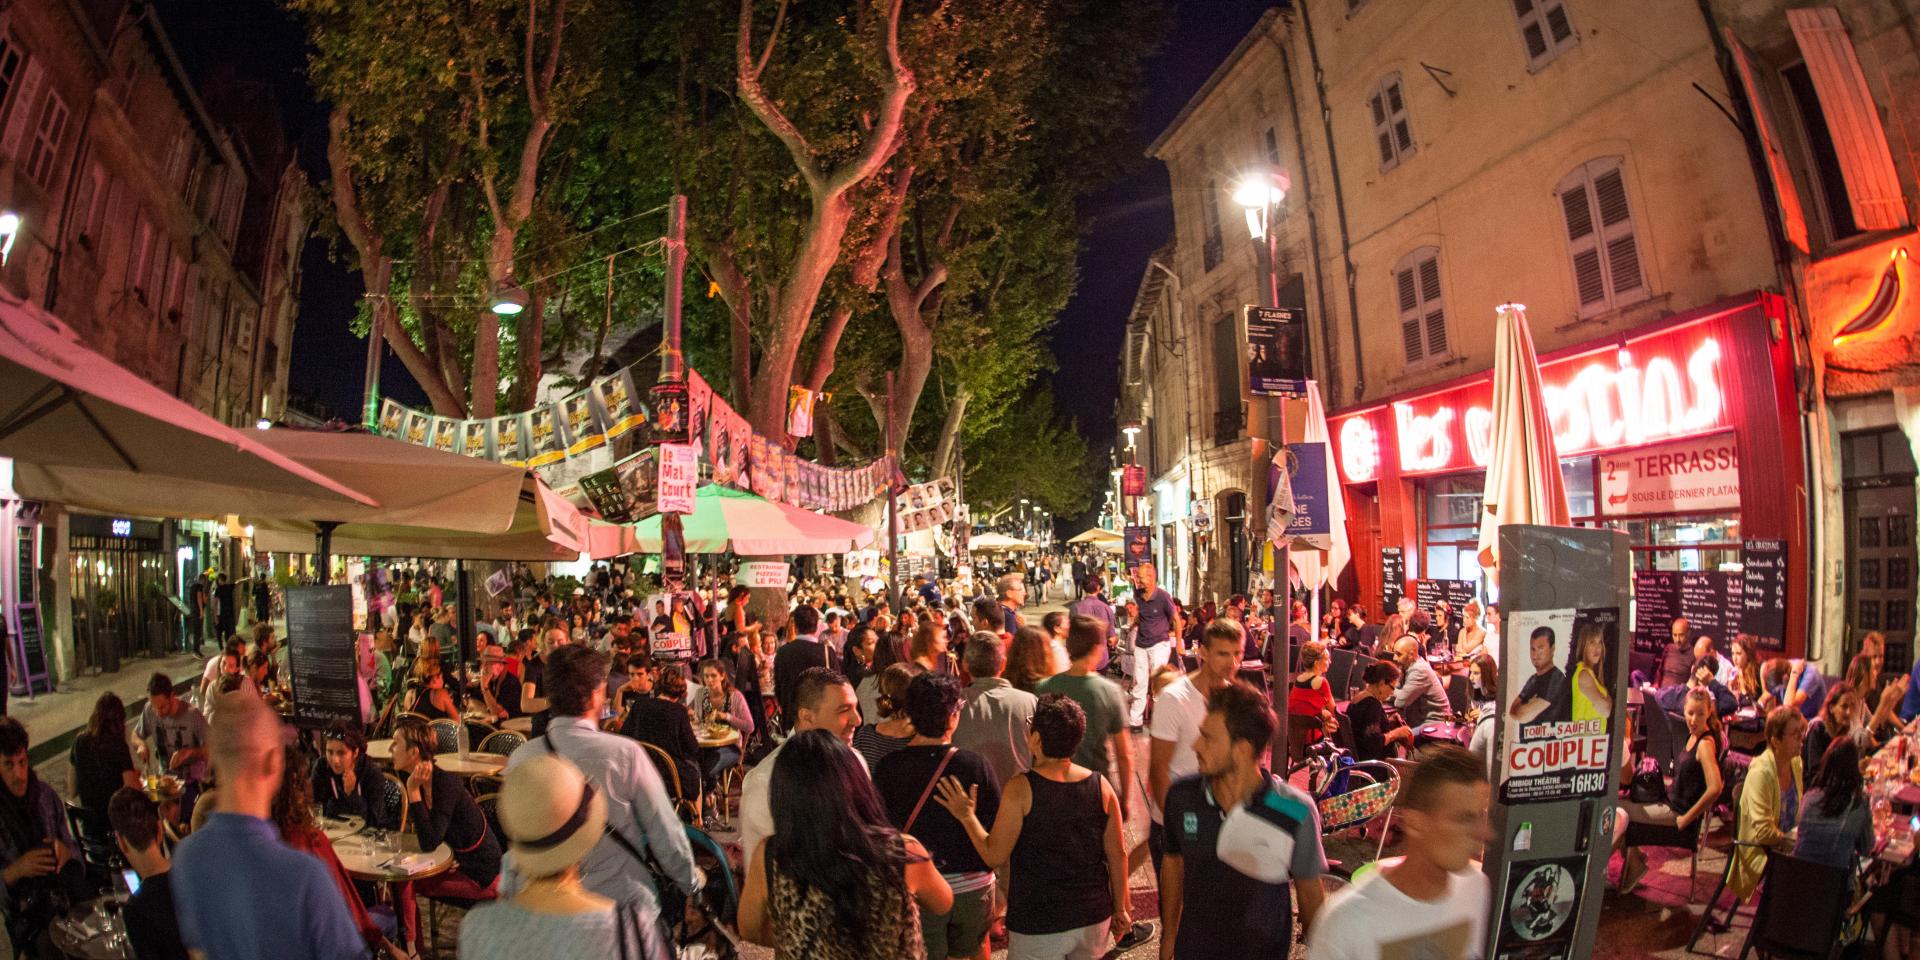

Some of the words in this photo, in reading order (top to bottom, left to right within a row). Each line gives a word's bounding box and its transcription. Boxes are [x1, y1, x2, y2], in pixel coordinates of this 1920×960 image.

[661, 481, 692, 498] Court
[1632, 490, 1655, 503] SOUS
[1656, 490, 1667, 501] LE
[1668, 488, 1705, 500] DERNIER
[653, 640, 691, 650] COUPLE
[1557, 723, 1585, 735] SAUF
[1586, 720, 1600, 732] LE
[1510, 738, 1607, 770] COUPLE
[1570, 773, 1606, 794] 16H30
